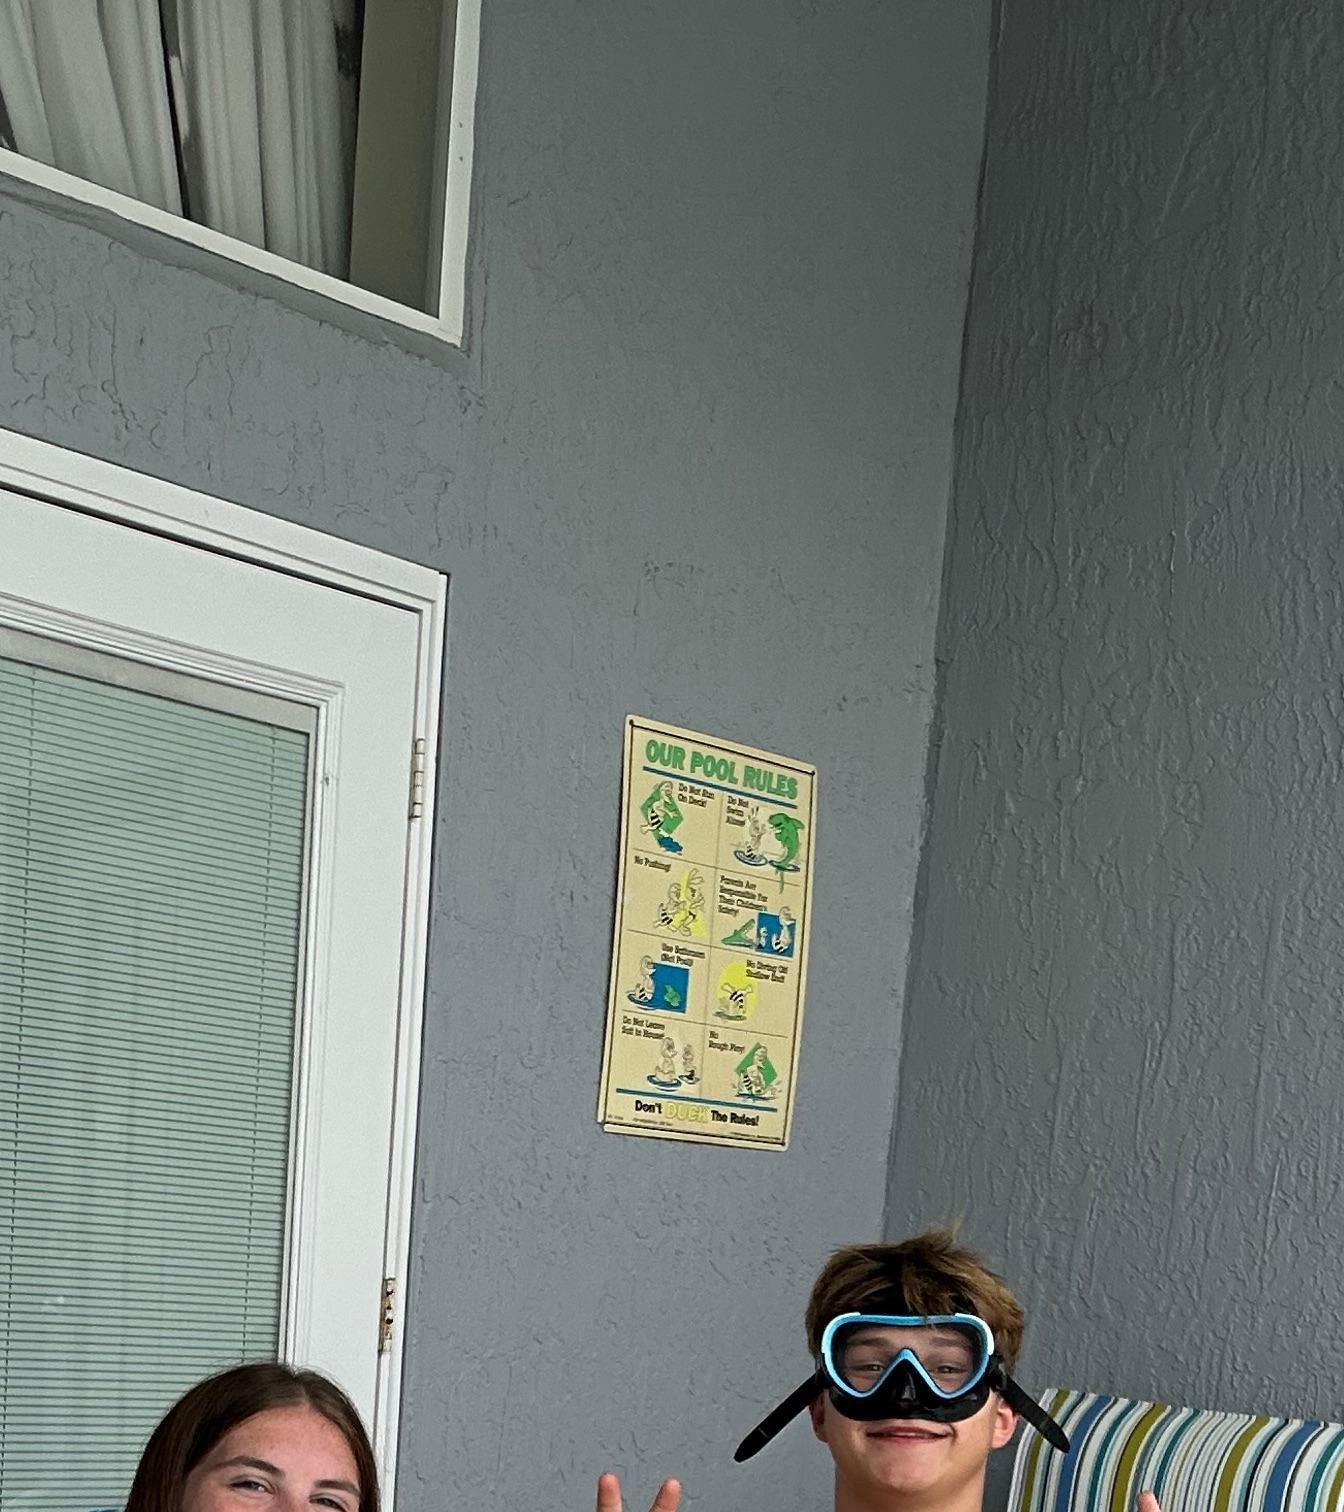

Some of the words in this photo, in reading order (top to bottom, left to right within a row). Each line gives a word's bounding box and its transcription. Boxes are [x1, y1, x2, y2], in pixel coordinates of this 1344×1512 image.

[645, 739, 686, 771] OUR
[690, 751, 739, 785] POOL
[743, 765, 798, 800] RULES
[678, 782, 687, 793] Do
[689, 785, 700, 796] Not
[677, 792, 686, 802] On
[727, 795, 736, 805] Do
[738, 798, 749, 807] Not
[634, 855, 643, 865] No
[623, 1015, 631, 1024] Do
[633, 1017, 643, 1026] Not
[709, 1030, 718, 1038] No
[635, 1100, 662, 1113] Don't
[664, 1101, 709, 1123] DUCK
[710, 1110, 727, 1122] The
[730, 1112, 759, 1126] Rules!
